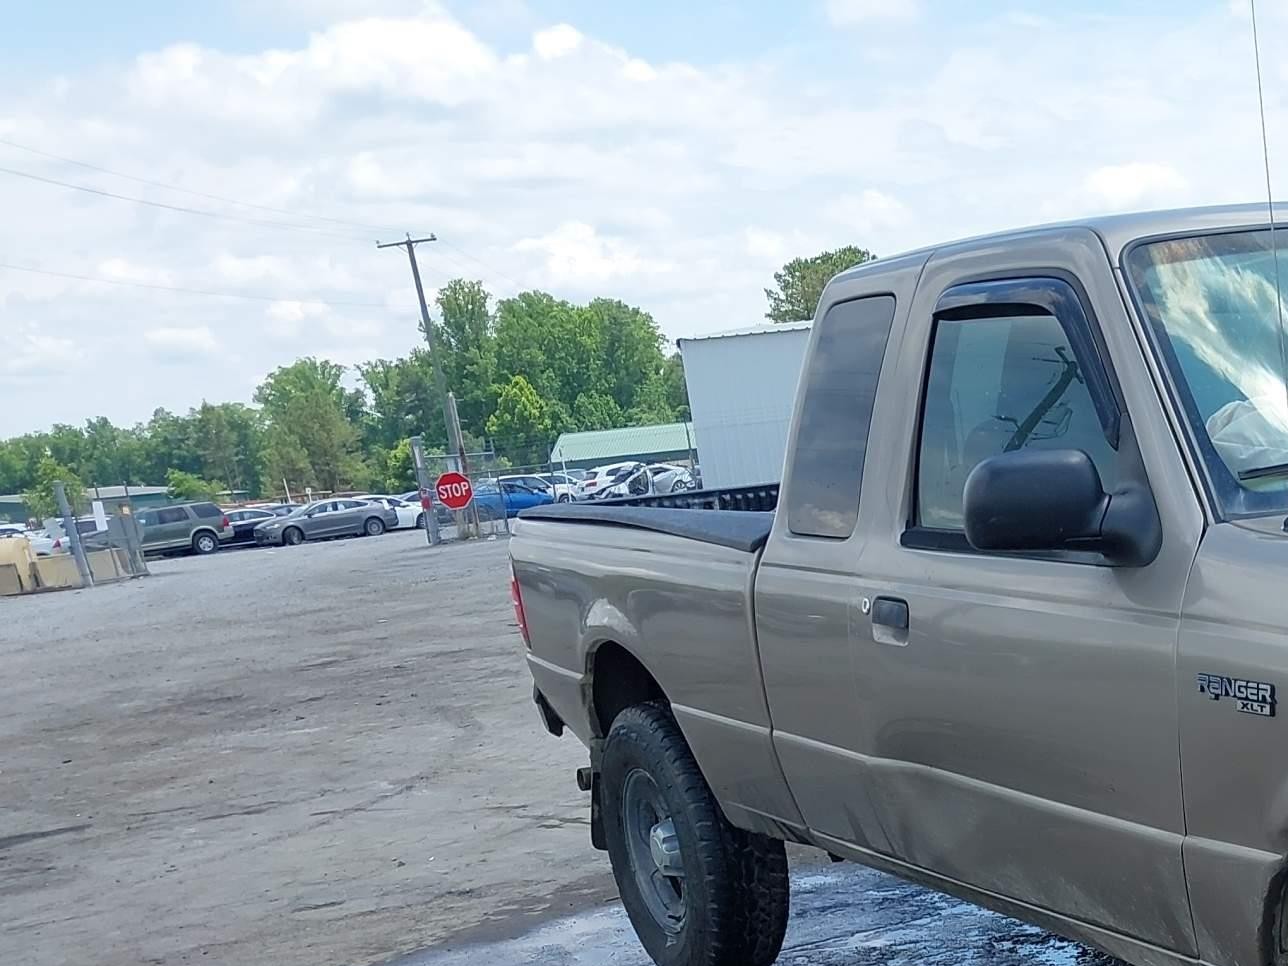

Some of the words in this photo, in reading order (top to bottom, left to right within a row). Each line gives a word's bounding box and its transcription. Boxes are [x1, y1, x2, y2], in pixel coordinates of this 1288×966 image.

[438, 481, 470, 500] STOP
[1196, 673, 1275, 704] RANGER
[1240, 701, 1267, 713] XLT
